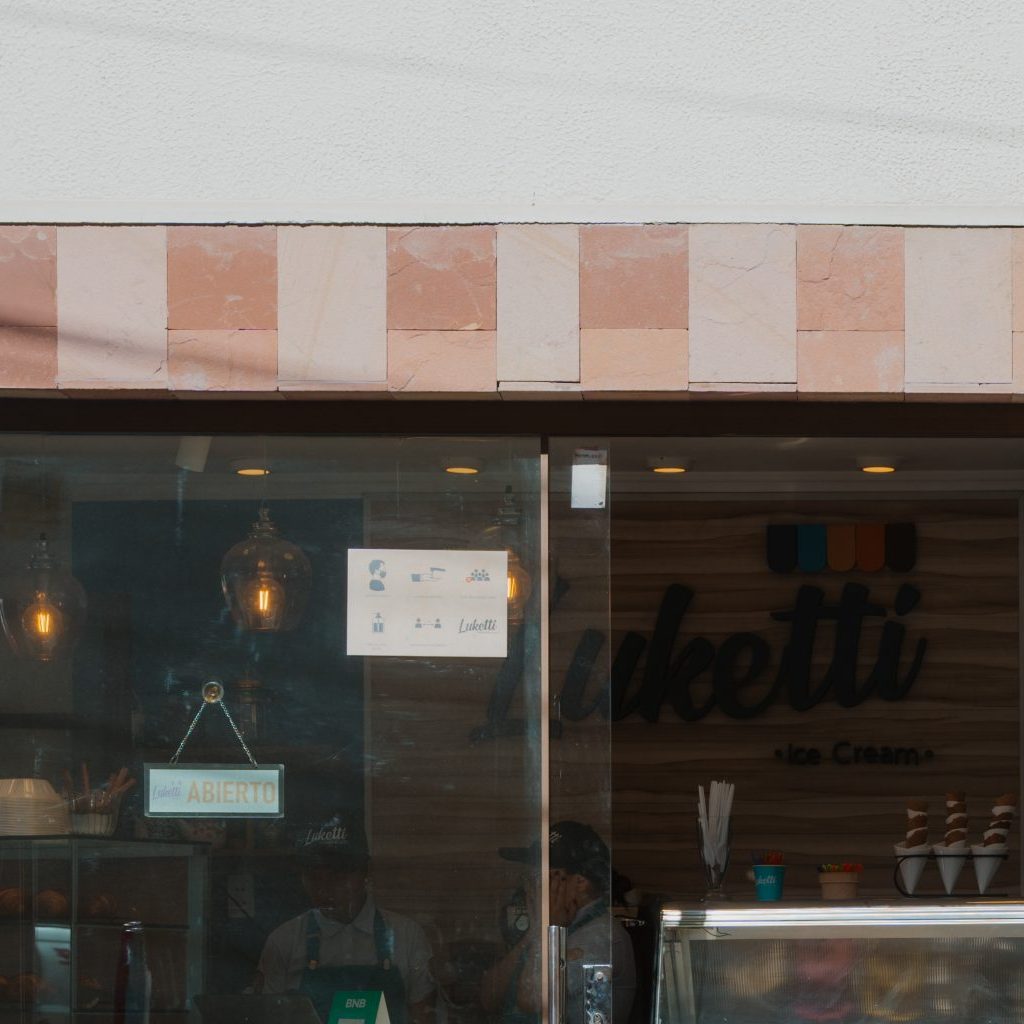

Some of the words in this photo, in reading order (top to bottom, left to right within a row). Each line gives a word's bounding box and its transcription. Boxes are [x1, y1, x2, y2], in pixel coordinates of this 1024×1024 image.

[458, 618, 497, 634] Luketti
[788, 743, 820, 766] Ice
[832, 742, 919, 766] Cream
[187, 780, 277, 804] ABIERTO
[345, 998, 367, 1009] BNB
